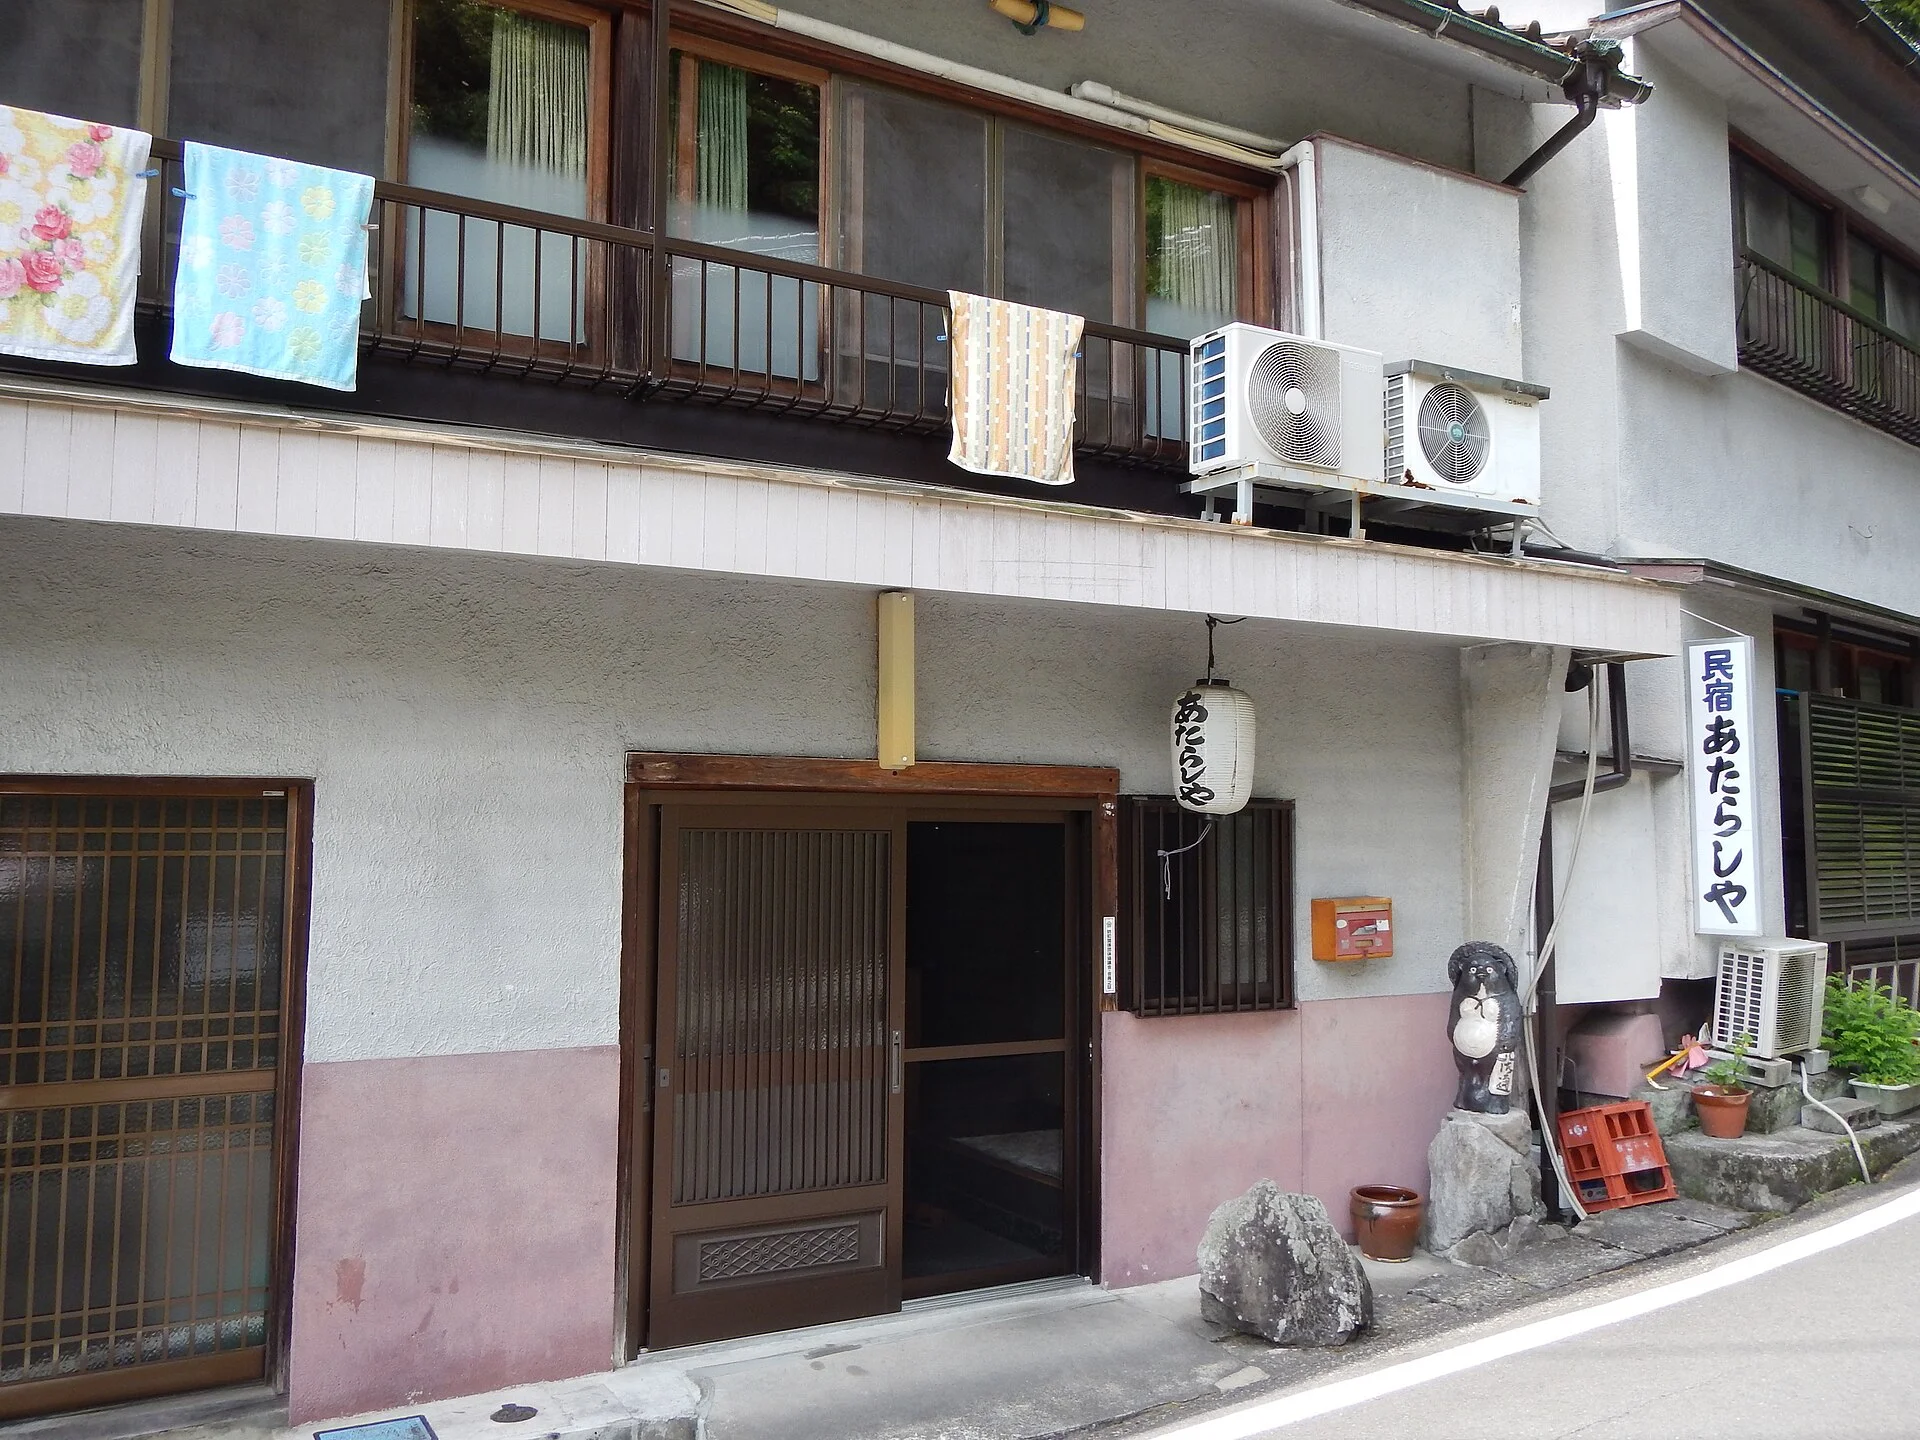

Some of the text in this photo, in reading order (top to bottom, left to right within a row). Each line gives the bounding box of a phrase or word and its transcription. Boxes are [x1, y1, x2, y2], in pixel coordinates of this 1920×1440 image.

[1503, 397, 1532, 408] TOSHIBA
[1174, 690, 1216, 807] あたらしや
